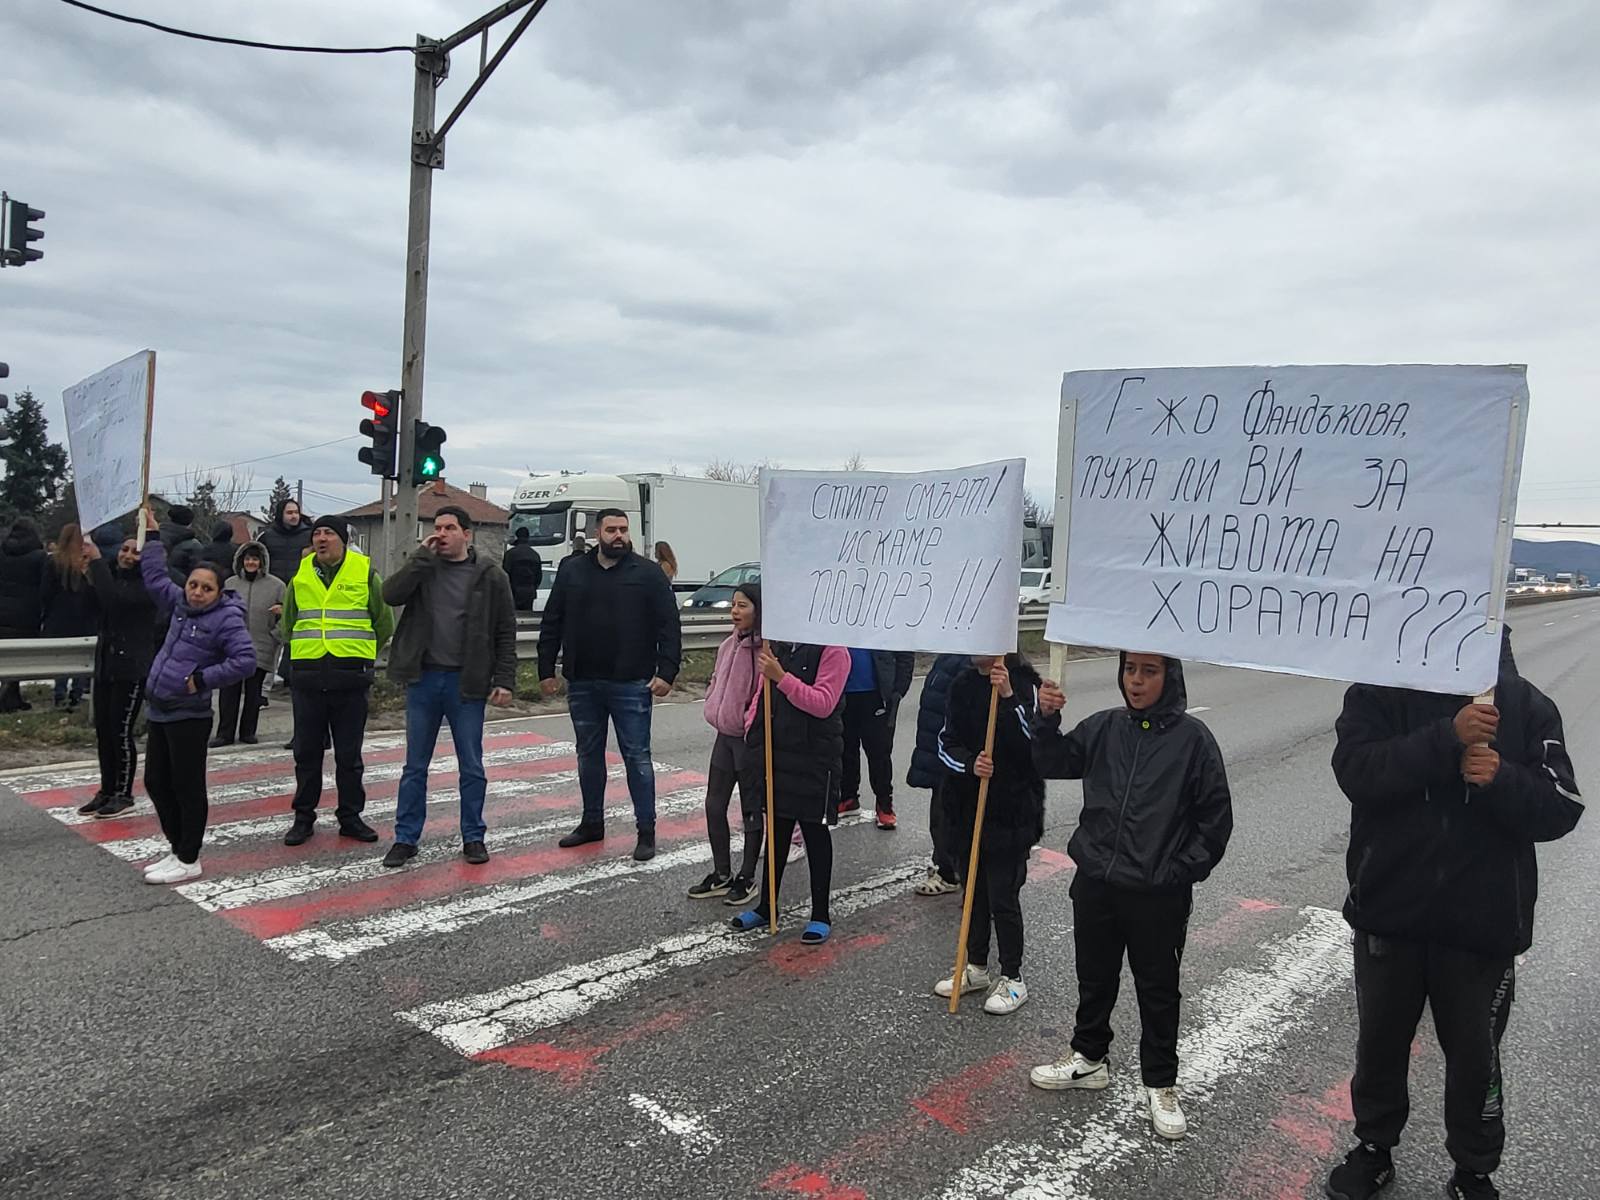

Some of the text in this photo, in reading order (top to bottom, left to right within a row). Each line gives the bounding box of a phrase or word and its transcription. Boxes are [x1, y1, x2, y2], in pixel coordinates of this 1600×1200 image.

[812, 483, 889, 521] СТИГА
[1079, 444, 1408, 512] ПУКА ЛИ ВИ ЗА
[837, 526, 943, 566] ИСКАМЕ
[1141, 511, 1434, 585] ЖИВОТА НА
[1146, 579, 1371, 641] ХОРАТА
